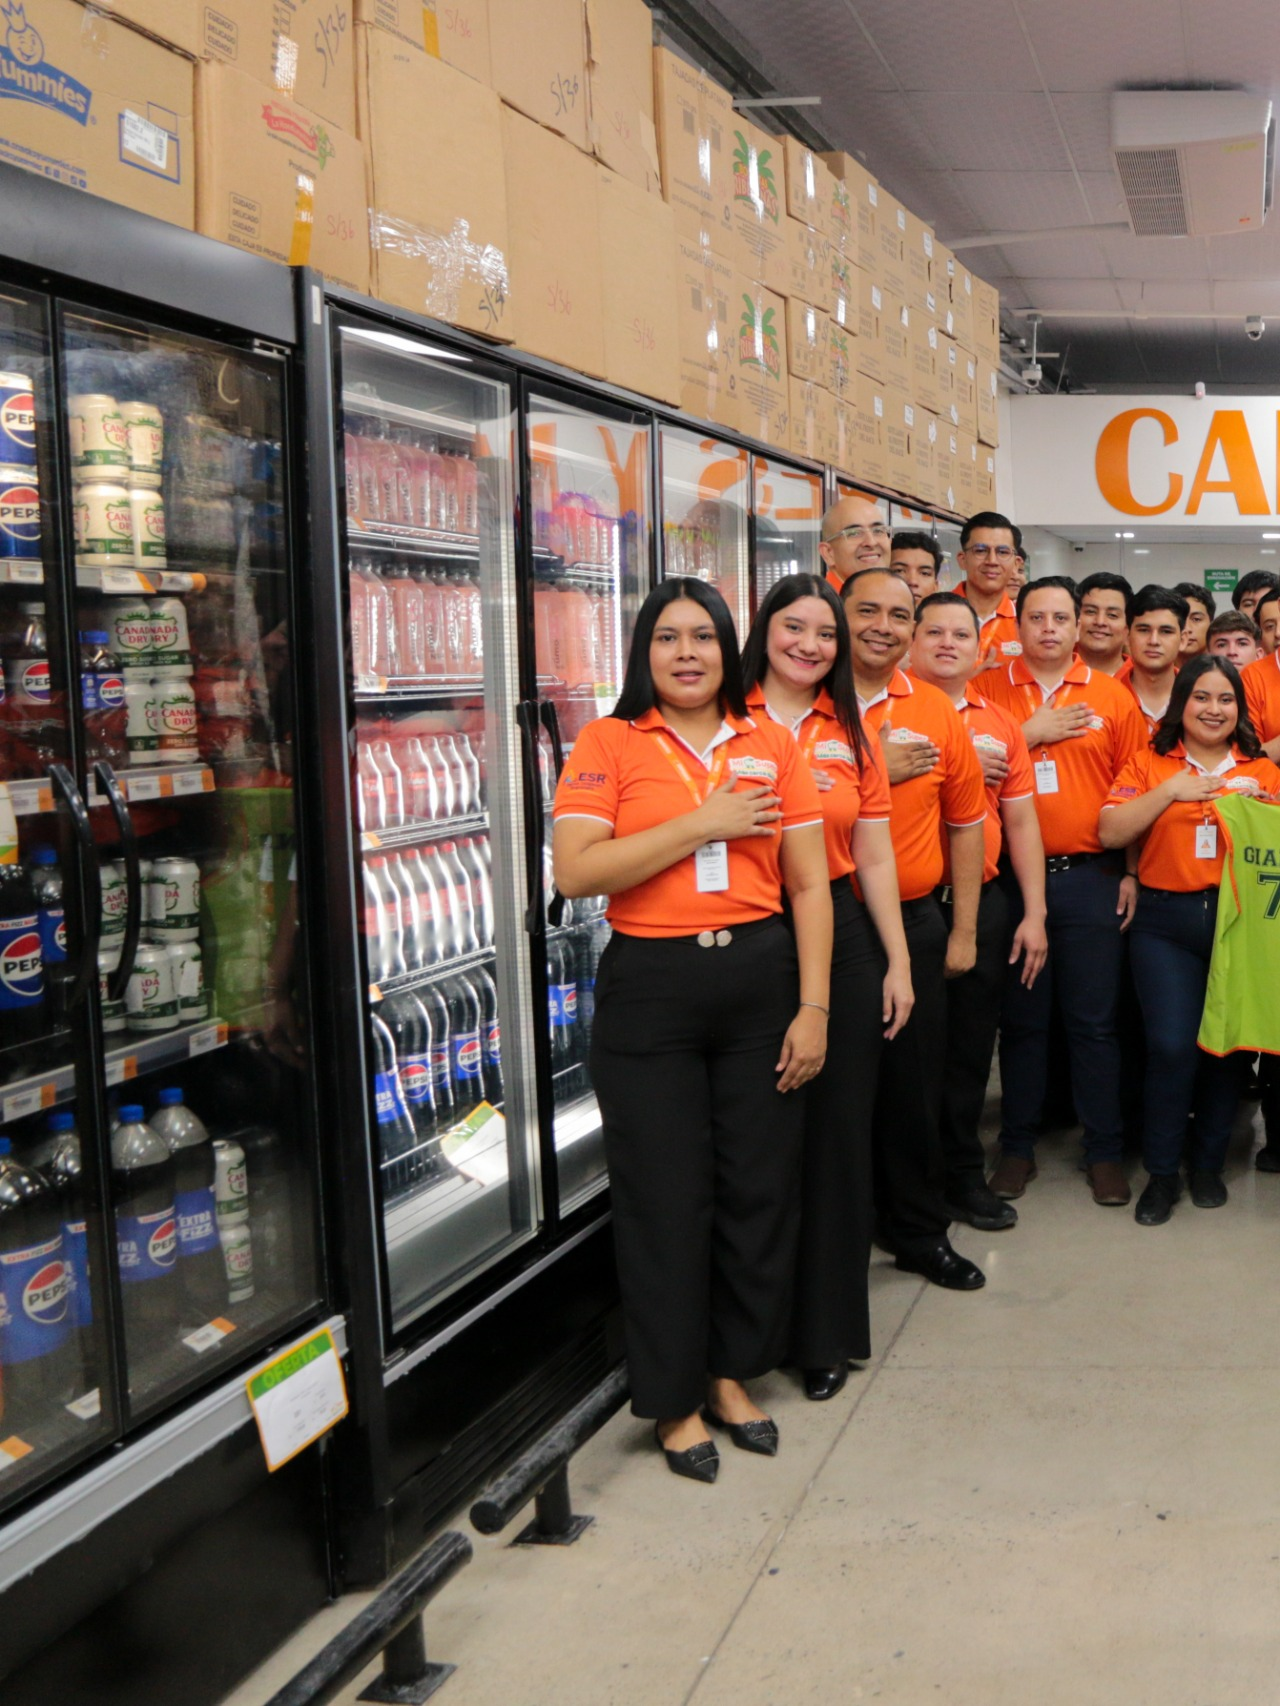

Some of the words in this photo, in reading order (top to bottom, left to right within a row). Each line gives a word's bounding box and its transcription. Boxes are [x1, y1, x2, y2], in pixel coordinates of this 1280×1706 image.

[0, 54, 87, 113] ummies
[5, 412, 34, 424] PEP
[578, 771, 606, 785] ESR
[262, 1342, 320, 1389] OFERTA
